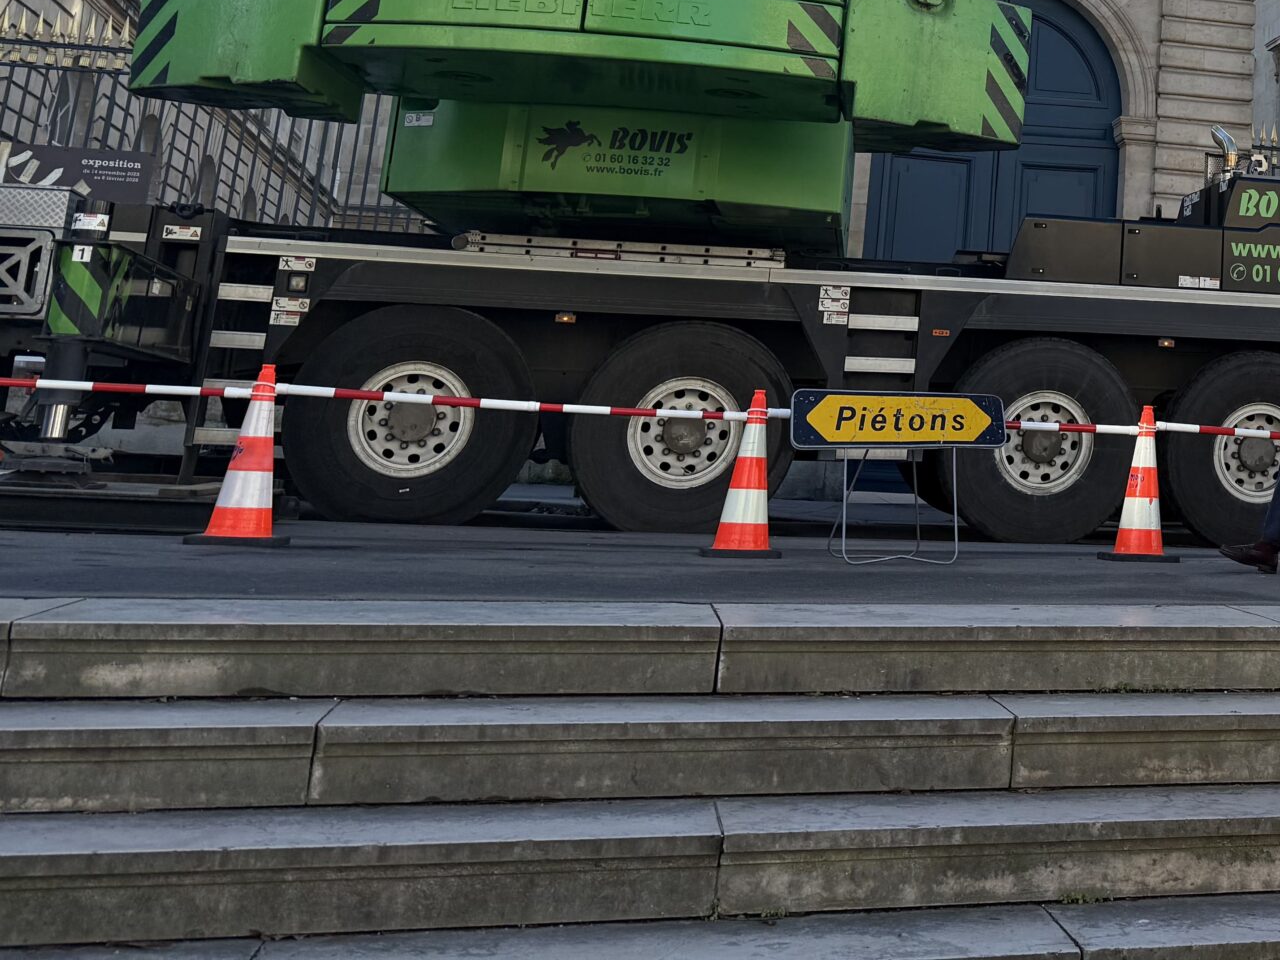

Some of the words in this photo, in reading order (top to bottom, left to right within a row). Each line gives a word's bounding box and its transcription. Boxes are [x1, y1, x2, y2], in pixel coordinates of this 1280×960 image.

[609, 127, 693, 154] BOVIS
[81, 158, 141, 169] exposition
[594, 152, 606, 162] 01
[610, 153, 624, 164] 60
[627, 154, 639, 165] 16
[641, 155, 655, 166] 32
[657, 156, 671, 167] 32
[586, 165, 663, 177] www.bovis.fr
[78, 247, 86, 260] 1
[1252, 264, 1271, 283] 01
[835, 406, 965, 431] Piétons
